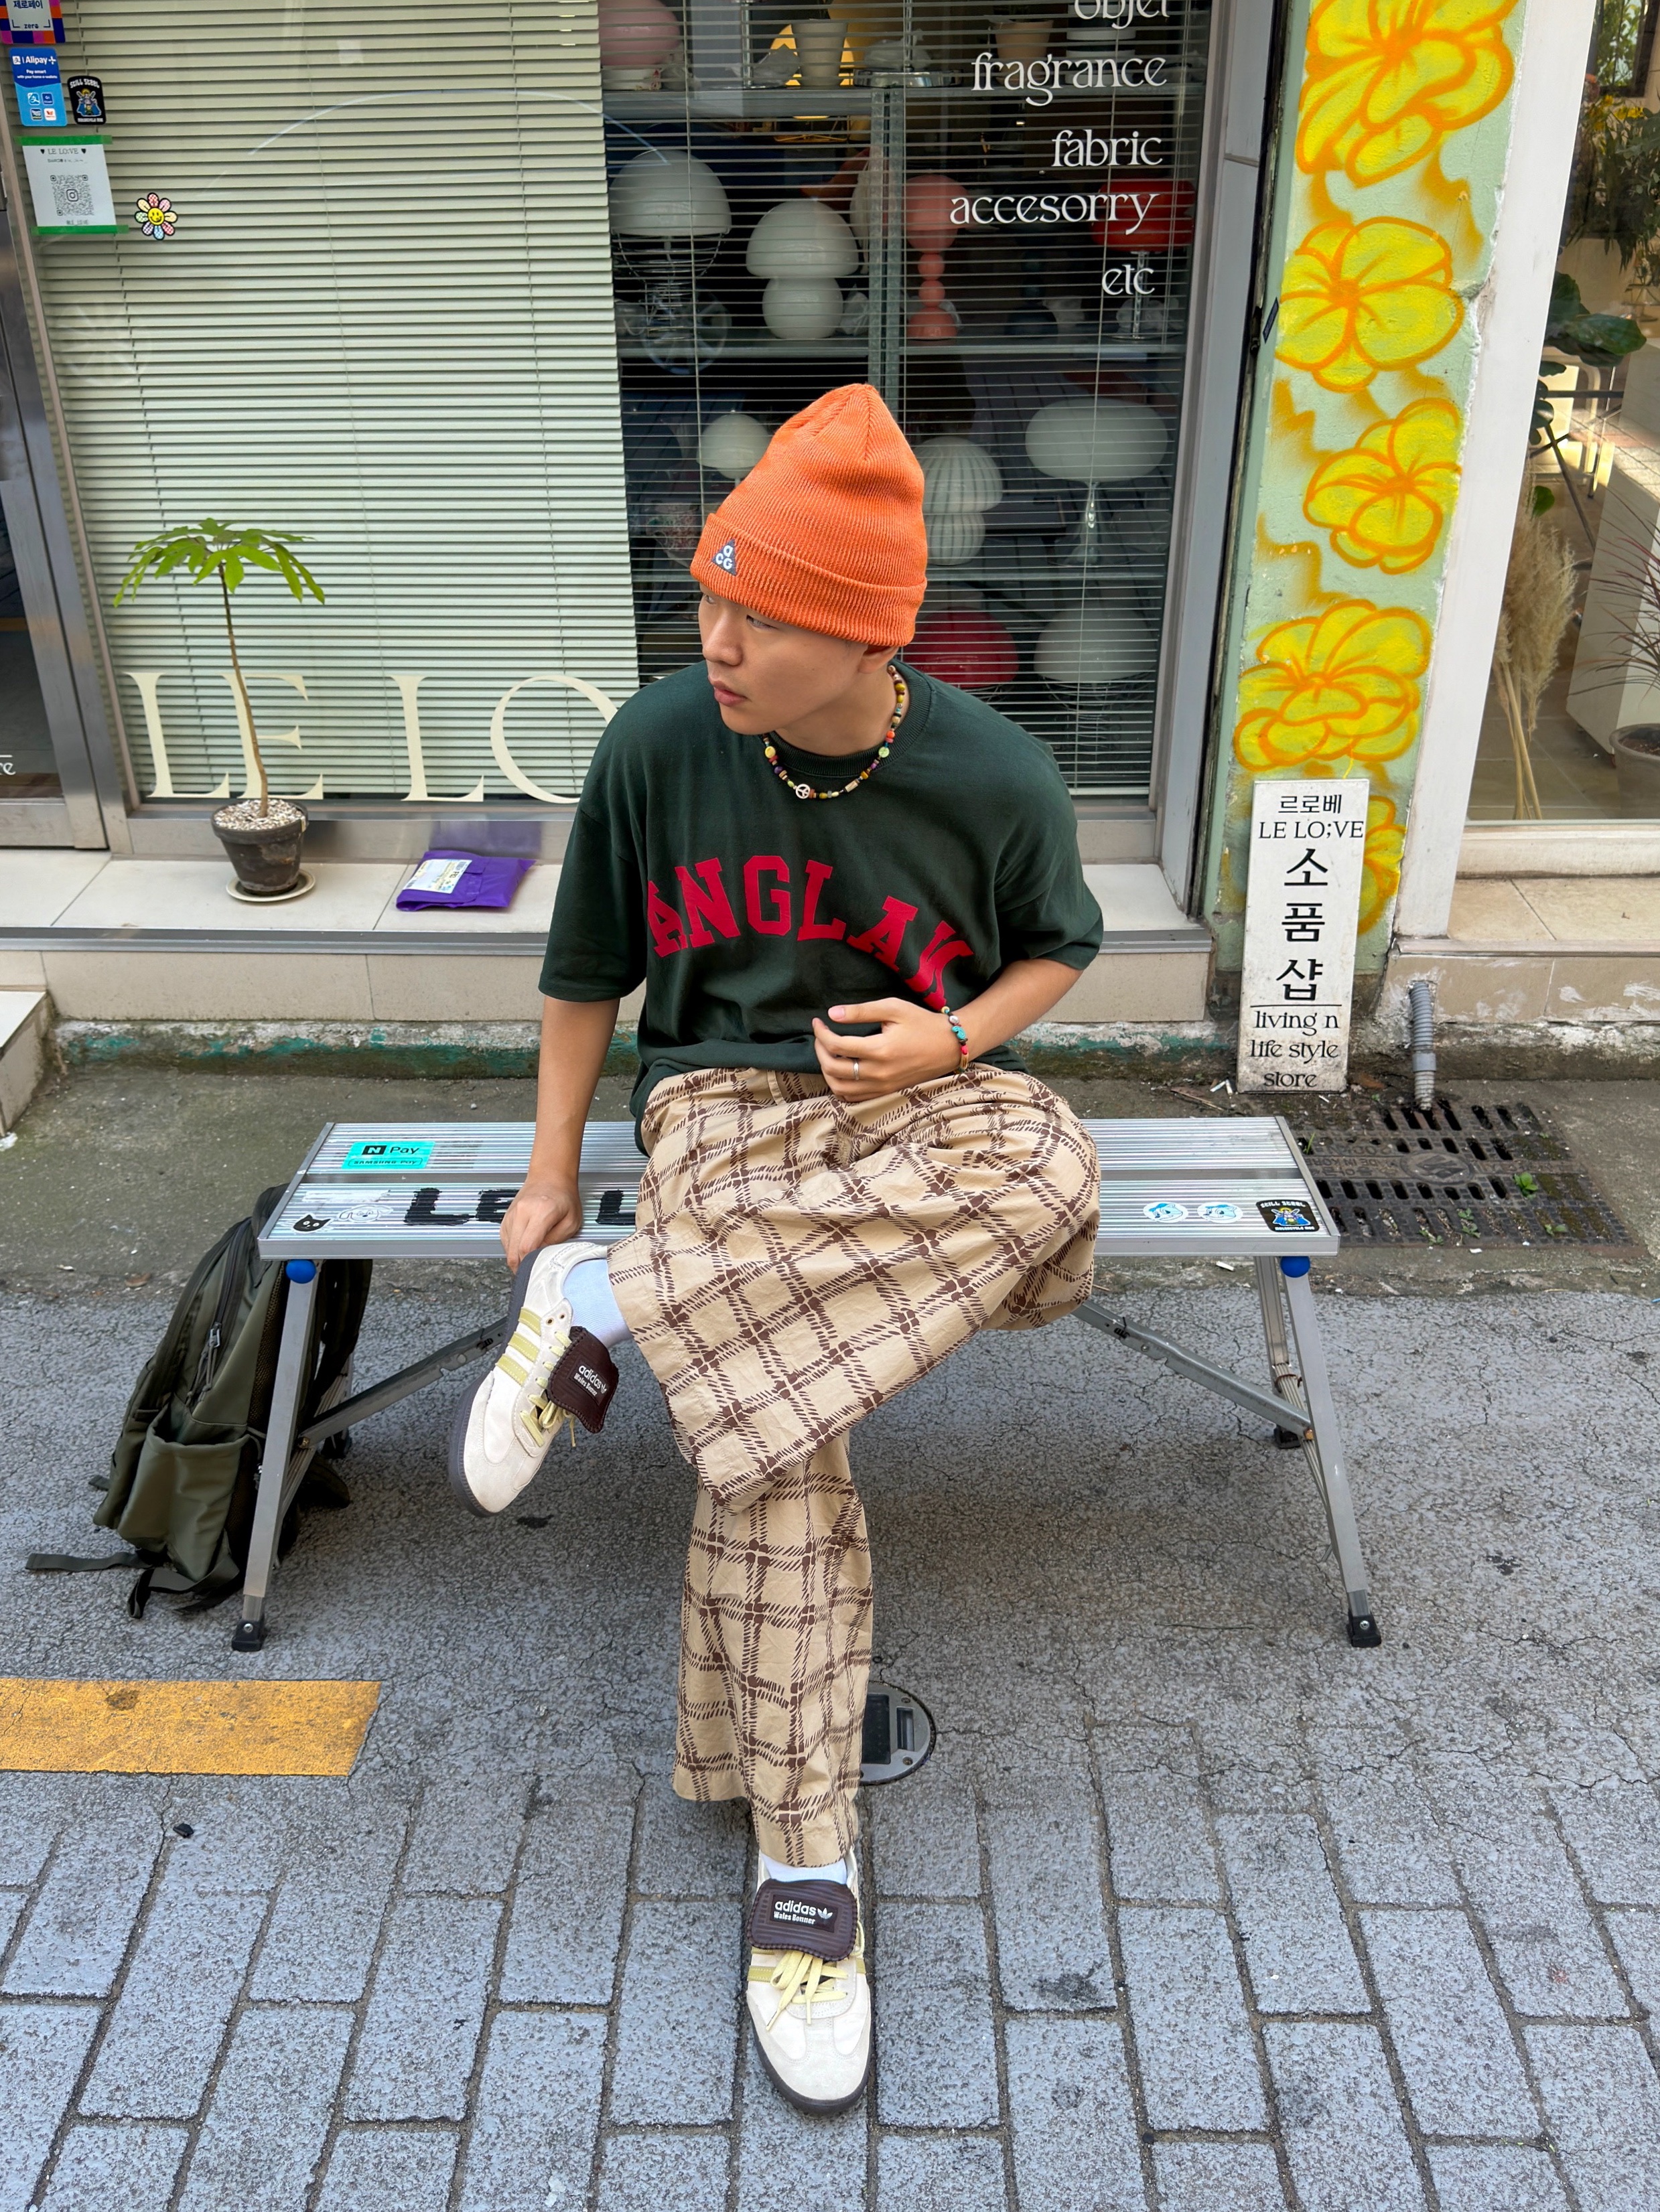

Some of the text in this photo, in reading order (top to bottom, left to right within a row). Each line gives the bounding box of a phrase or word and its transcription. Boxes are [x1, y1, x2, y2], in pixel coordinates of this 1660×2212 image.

[1075, 0, 1170, 29] objet
[971, 52, 1168, 106] fragrance
[1051, 129, 1164, 167] fabric
[950, 193, 1160, 235] accesorry
[1101, 265, 1156, 295] etc
[125, 672, 324, 800] LE
[1277, 794, 1342, 814] 르로베
[1258, 821, 1365, 839] LE LO;VE
[1275, 848, 1328, 1001] 소품샵
[1253, 1011, 1340, 1037] living n
[1249, 1039, 1339, 1065] life style
[1263, 1072, 1318, 1088] store
[389, 1147, 420, 1155] Pay
[574, 1373, 586, 1386] Wales
[579, 1366, 602, 1389] adidas
[774, 1911, 815, 1924] Wales Bonner
[775, 1901, 816, 1916] adidas
